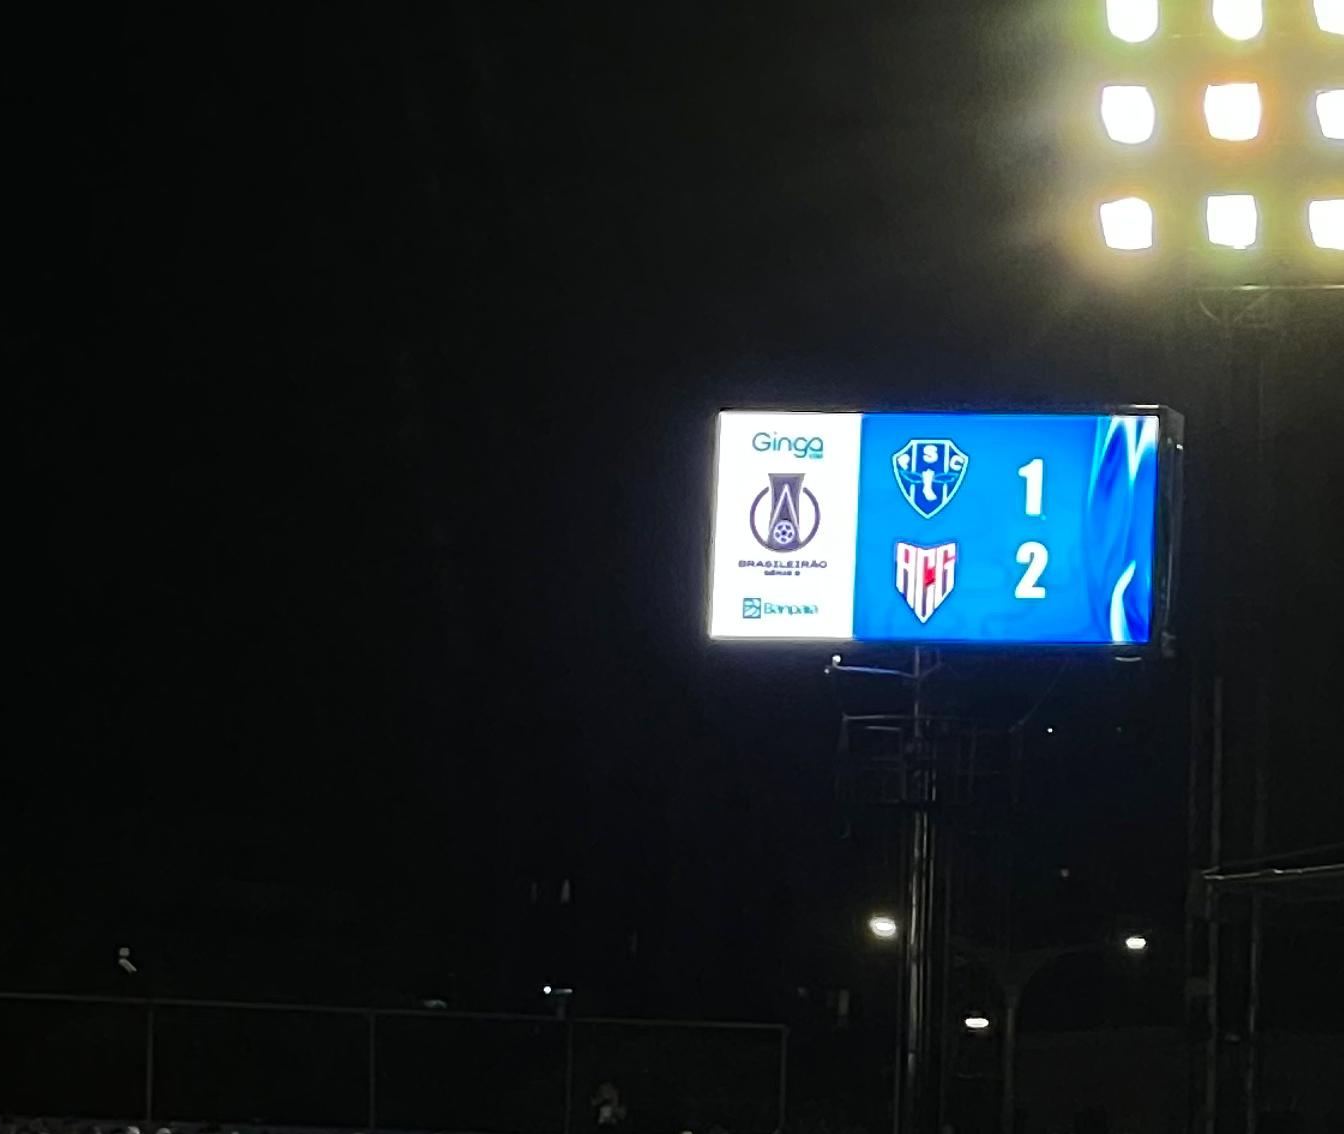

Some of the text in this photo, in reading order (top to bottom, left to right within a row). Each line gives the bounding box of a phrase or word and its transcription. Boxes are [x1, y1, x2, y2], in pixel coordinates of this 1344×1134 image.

[752, 431, 823, 458] Ginga
[1018, 458, 1044, 515] 1
[1014, 541, 1049, 600] 2
